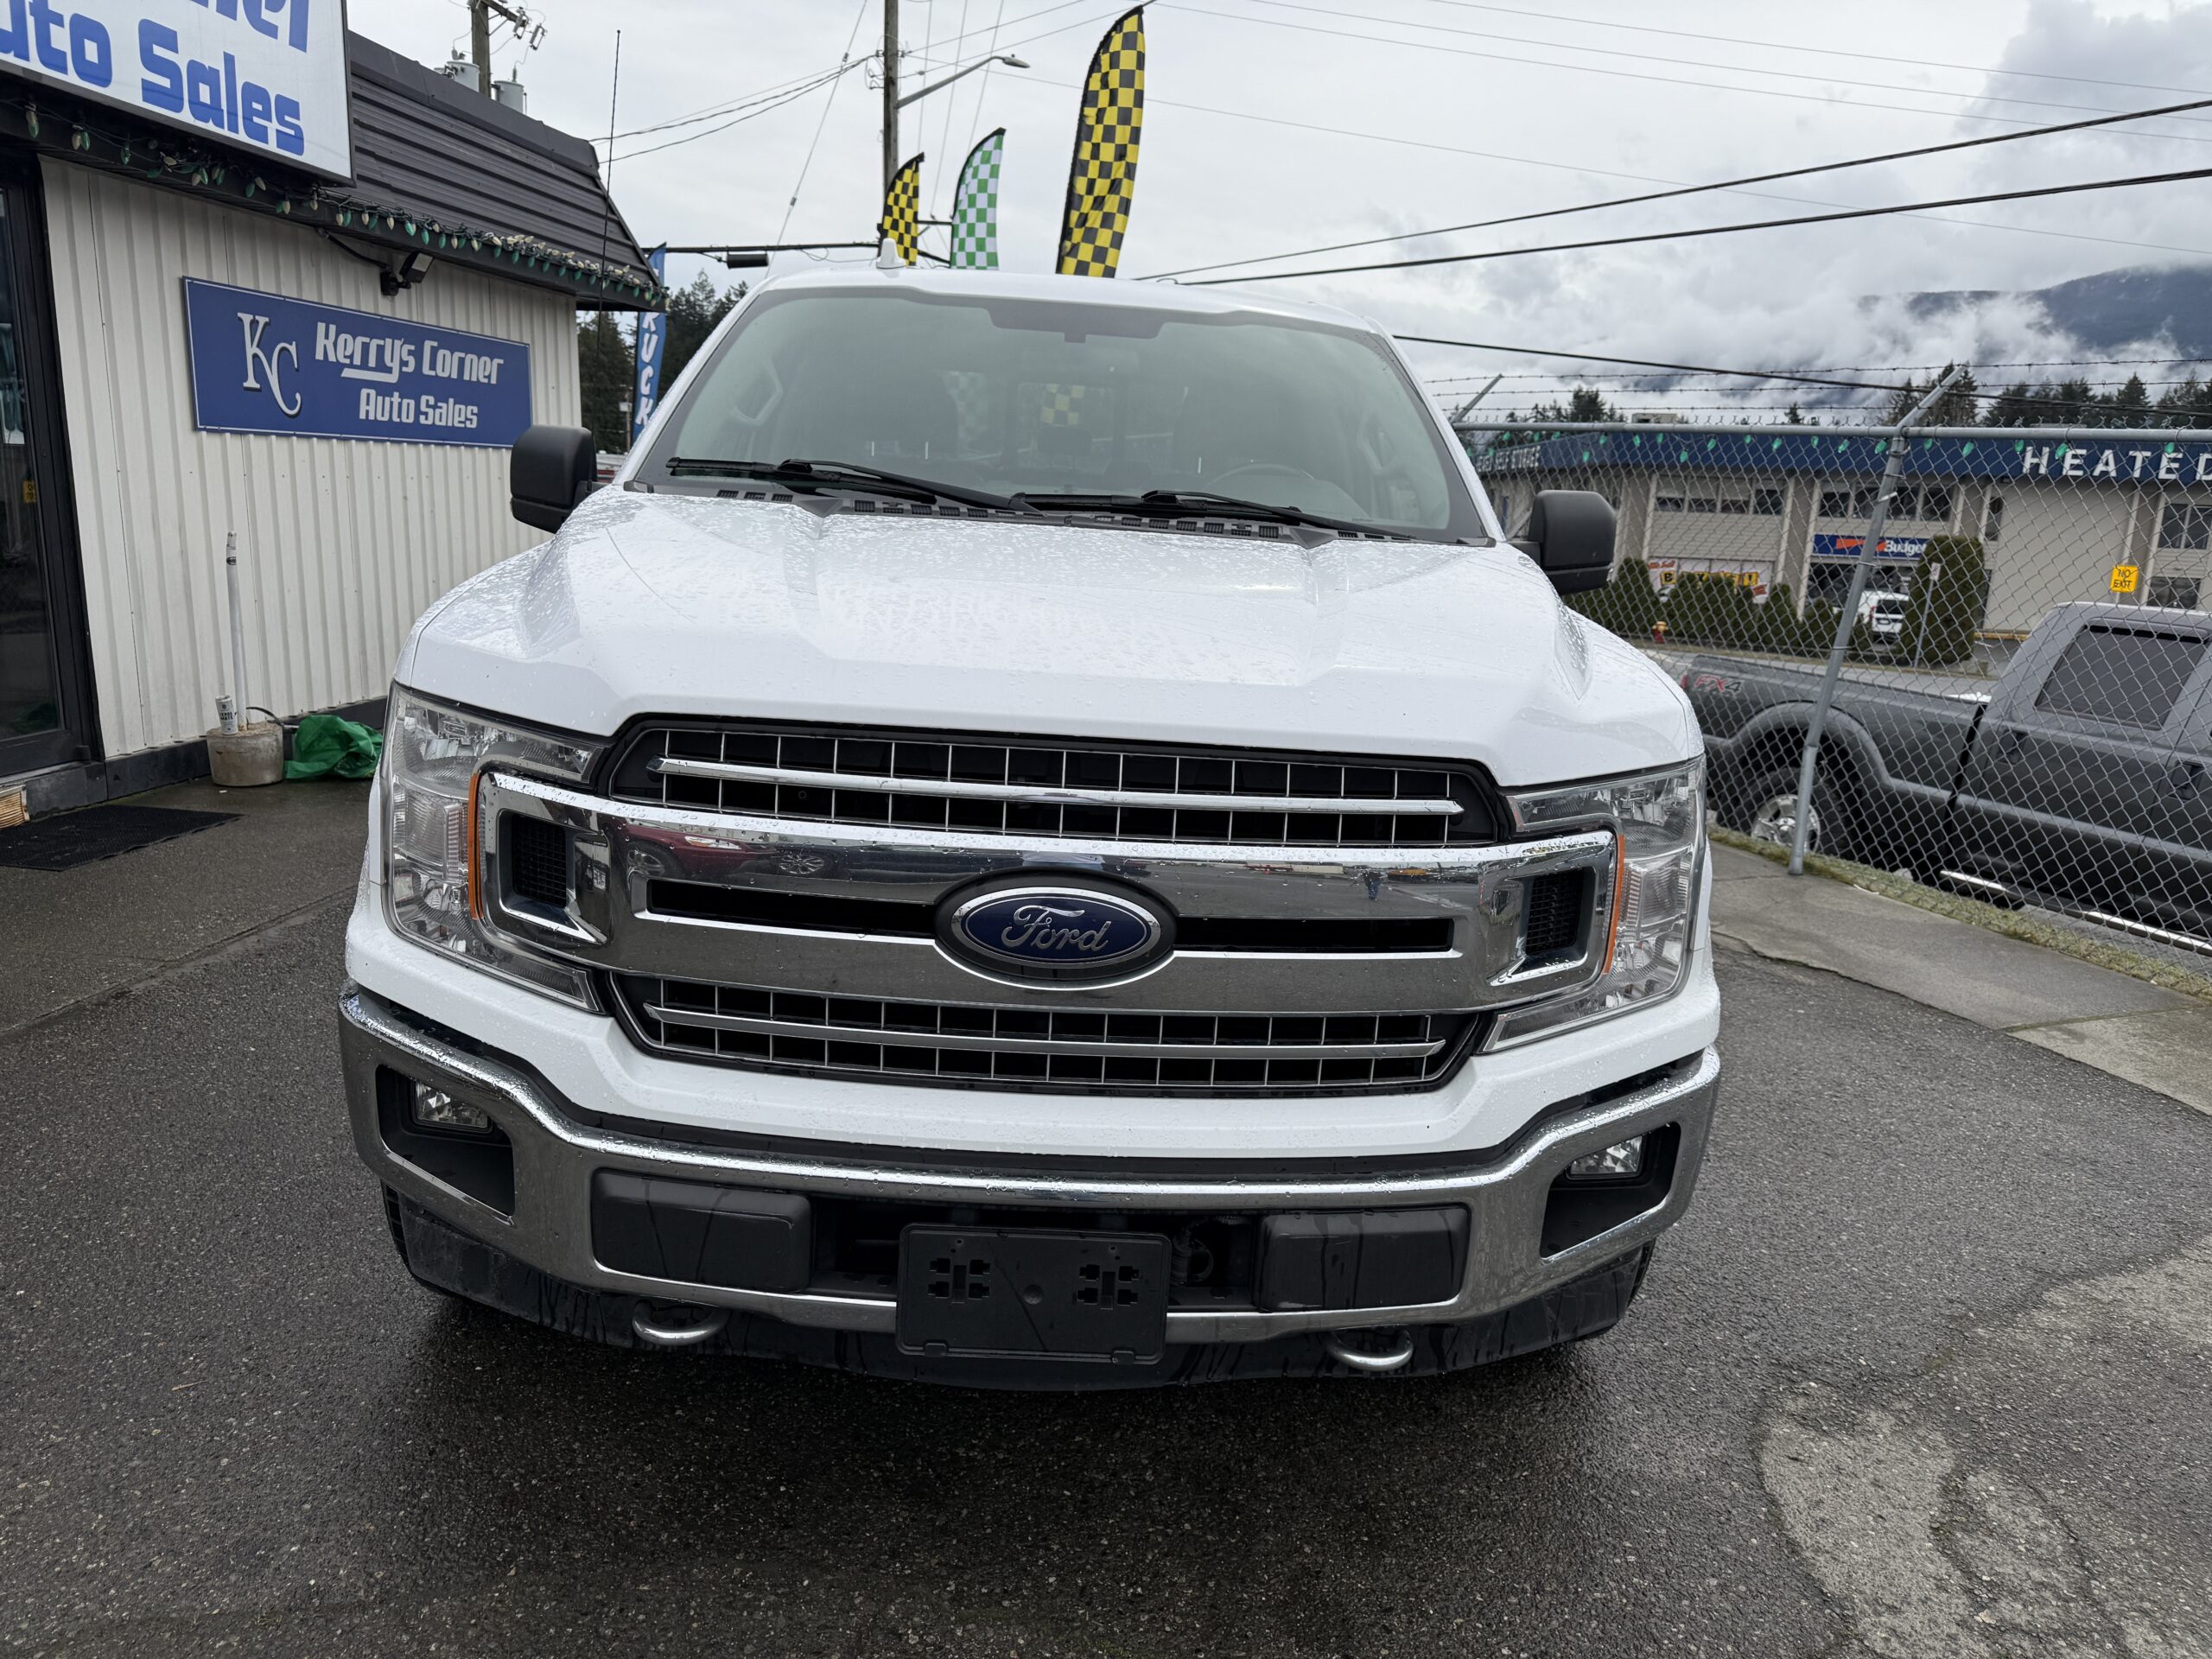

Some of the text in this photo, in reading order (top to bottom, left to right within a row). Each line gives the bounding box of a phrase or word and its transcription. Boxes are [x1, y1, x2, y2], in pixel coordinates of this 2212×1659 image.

[0, 0, 112, 88] uto
[138, 18, 305, 156] Sales
[237, 312, 302, 416] KC
[422, 340, 504, 385] Corner
[359, 388, 478, 429] Auto Sales
[2113, 579, 2133, 588] EXIT
[2117, 569, 2131, 578] NO
[1694, 675, 1744, 693] FX4
[1001, 905, 1112, 951] Ford
